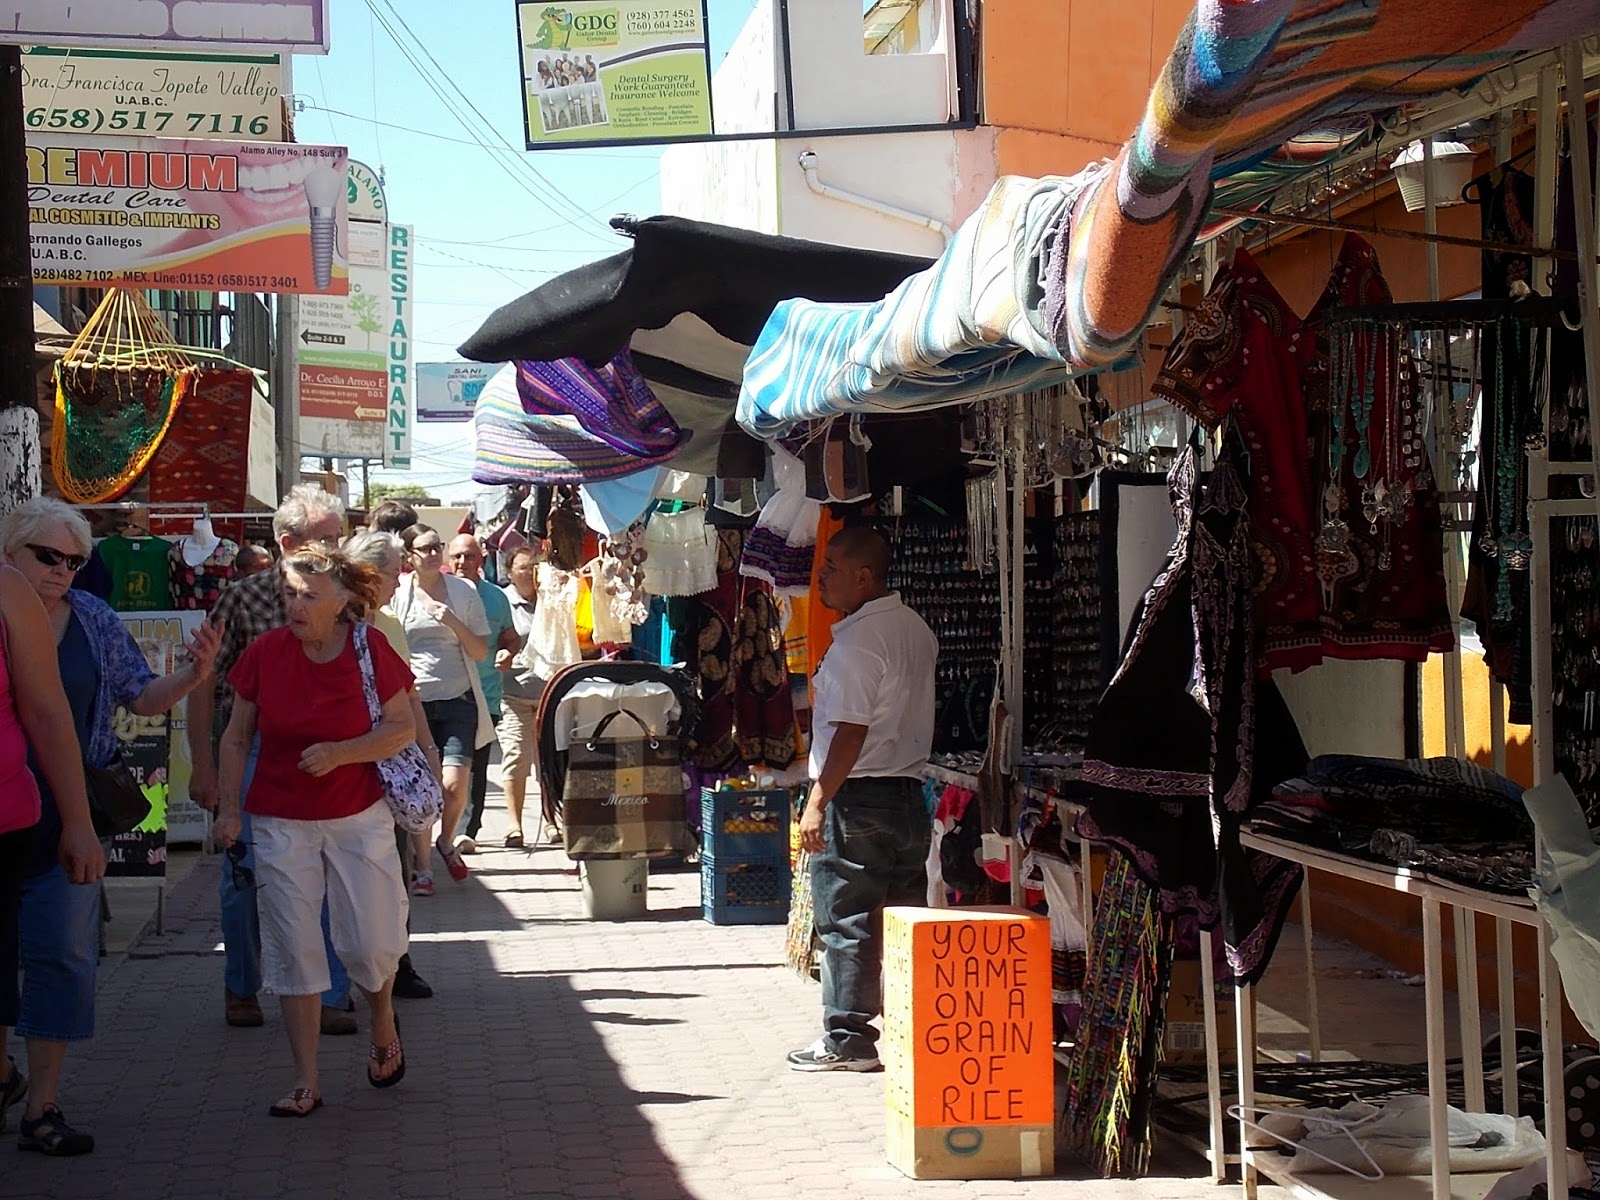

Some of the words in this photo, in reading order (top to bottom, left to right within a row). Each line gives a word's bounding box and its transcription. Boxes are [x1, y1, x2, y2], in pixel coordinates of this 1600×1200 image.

[573, 14, 618, 31] GDG
[626, 11, 651, 21] (928)
[653, 10, 670, 19] 377
[672, 9, 694, 18] 4562
[627, 21, 652, 31] (760)
[653, 20, 671, 29] 604
[673, 19, 696, 28] 2248
[57, 64, 144, 92] Francisca
[150, 68, 208, 102] Topete
[217, 66, 278, 105] Vallejo
[613, 82, 640, 92] Work
[641, 79, 696, 91] Guaranteed
[619, 73, 650, 84] Dental
[651, 73, 689, 83] Surgery
[115, 95, 168, 107] U.A.B.C.
[610, 91, 657, 100] Insurance
[659, 89, 700, 98] Welcome
[186, 113, 270, 135] 7116
[240, 146, 266, 155] Alamo
[266, 147, 286, 157] Alley
[303, 149, 318, 157] 148
[319, 149, 336, 158] Suit
[347, 164, 383, 210] ALAMO
[28, 186, 115, 205] Dental
[125, 190, 187, 209] Care
[49, 208, 128, 226] COSMETIC
[129, 212, 143, 227] &
[143, 211, 220, 230] IMPLANTS
[86, 234, 143, 249] Gallegos
[32, 248, 87, 261] U.A.B.C.
[86, 269, 113, 281] 7102
[122, 271, 150, 282] MEX.
[270, 276, 298, 288] 3401
[390, 226, 409, 452] RESTAURANT
[300, 371, 315, 383] Dr.
[316, 373, 345, 385] Cecilia
[347, 376, 377, 388] Arroyo
[601, 793, 650, 807] Mexico
[932, 923, 1028, 960] YOUR
[935, 956, 1028, 989] NAME
[935, 990, 984, 1019] ON
[1008, 988, 1025, 1019] A
[926, 1021, 1033, 1054] GRAIN
[960, 1055, 1007, 1085] OF
[942, 1085, 1024, 1123] RICE
